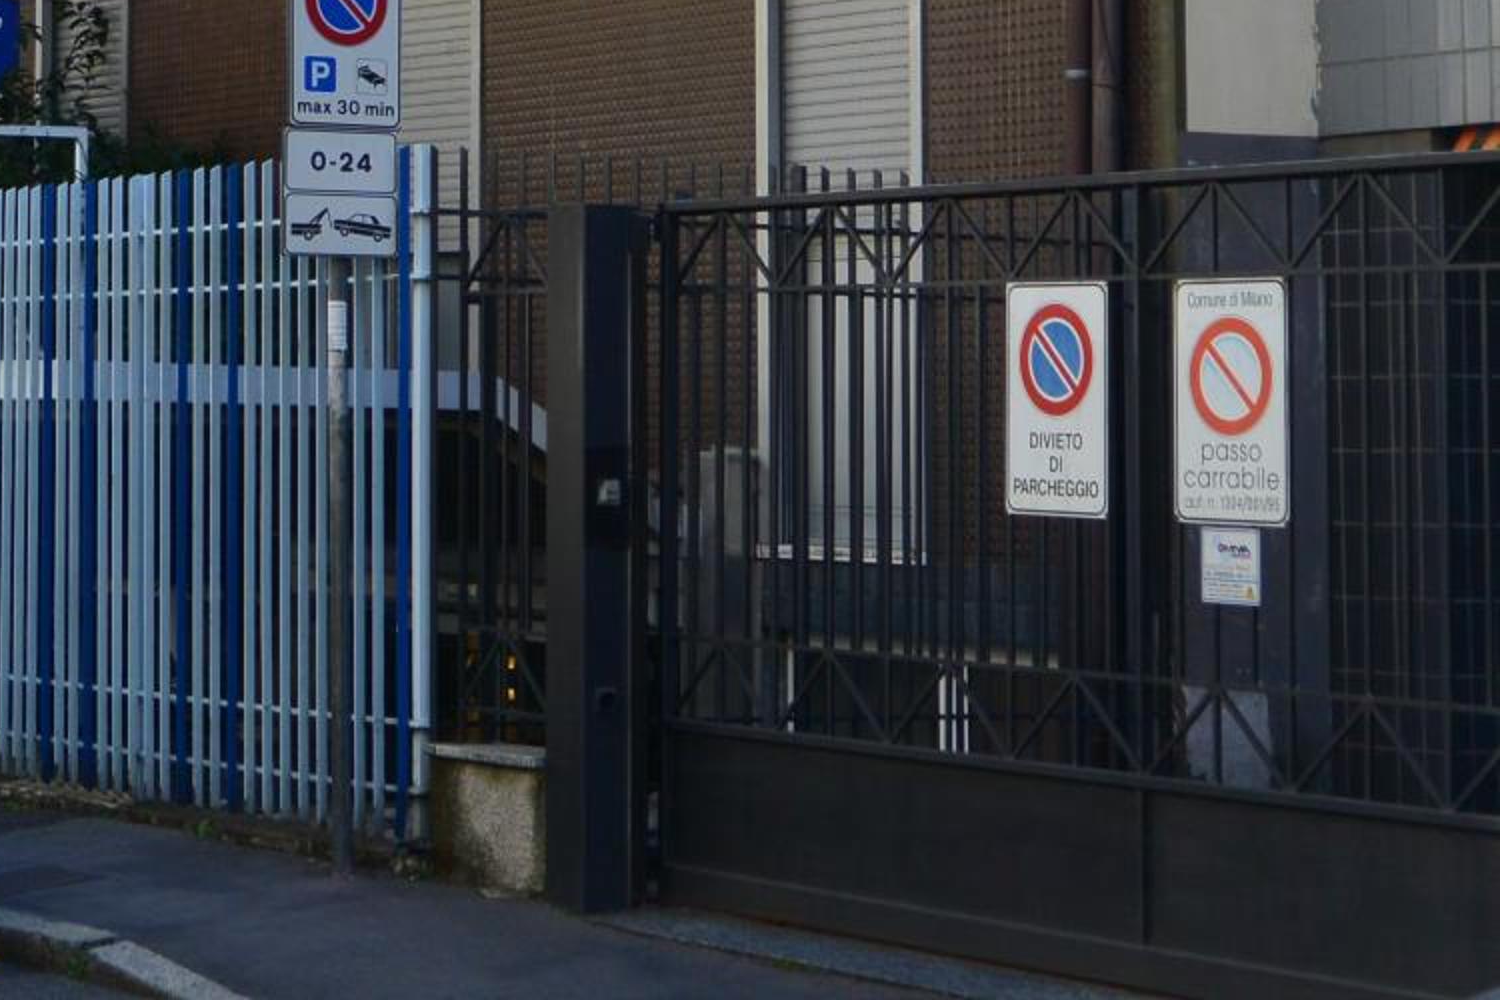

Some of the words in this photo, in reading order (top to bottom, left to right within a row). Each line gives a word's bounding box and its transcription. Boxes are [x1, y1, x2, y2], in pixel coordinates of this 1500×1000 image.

[311, 60, 331, 89] P
[297, 101, 332, 115] max
[337, 99, 360, 115] 30
[365, 101, 395, 117] min
[310, 150, 373, 173] 0-24
[1029, 431, 1083, 451] DIVIETO
[1049, 455, 1063, 473] DI
[1202, 443, 1262, 466] passo
[1013, 477, 1099, 498] PARCHEGGIO
[1184, 466, 1280, 490] carrabile
